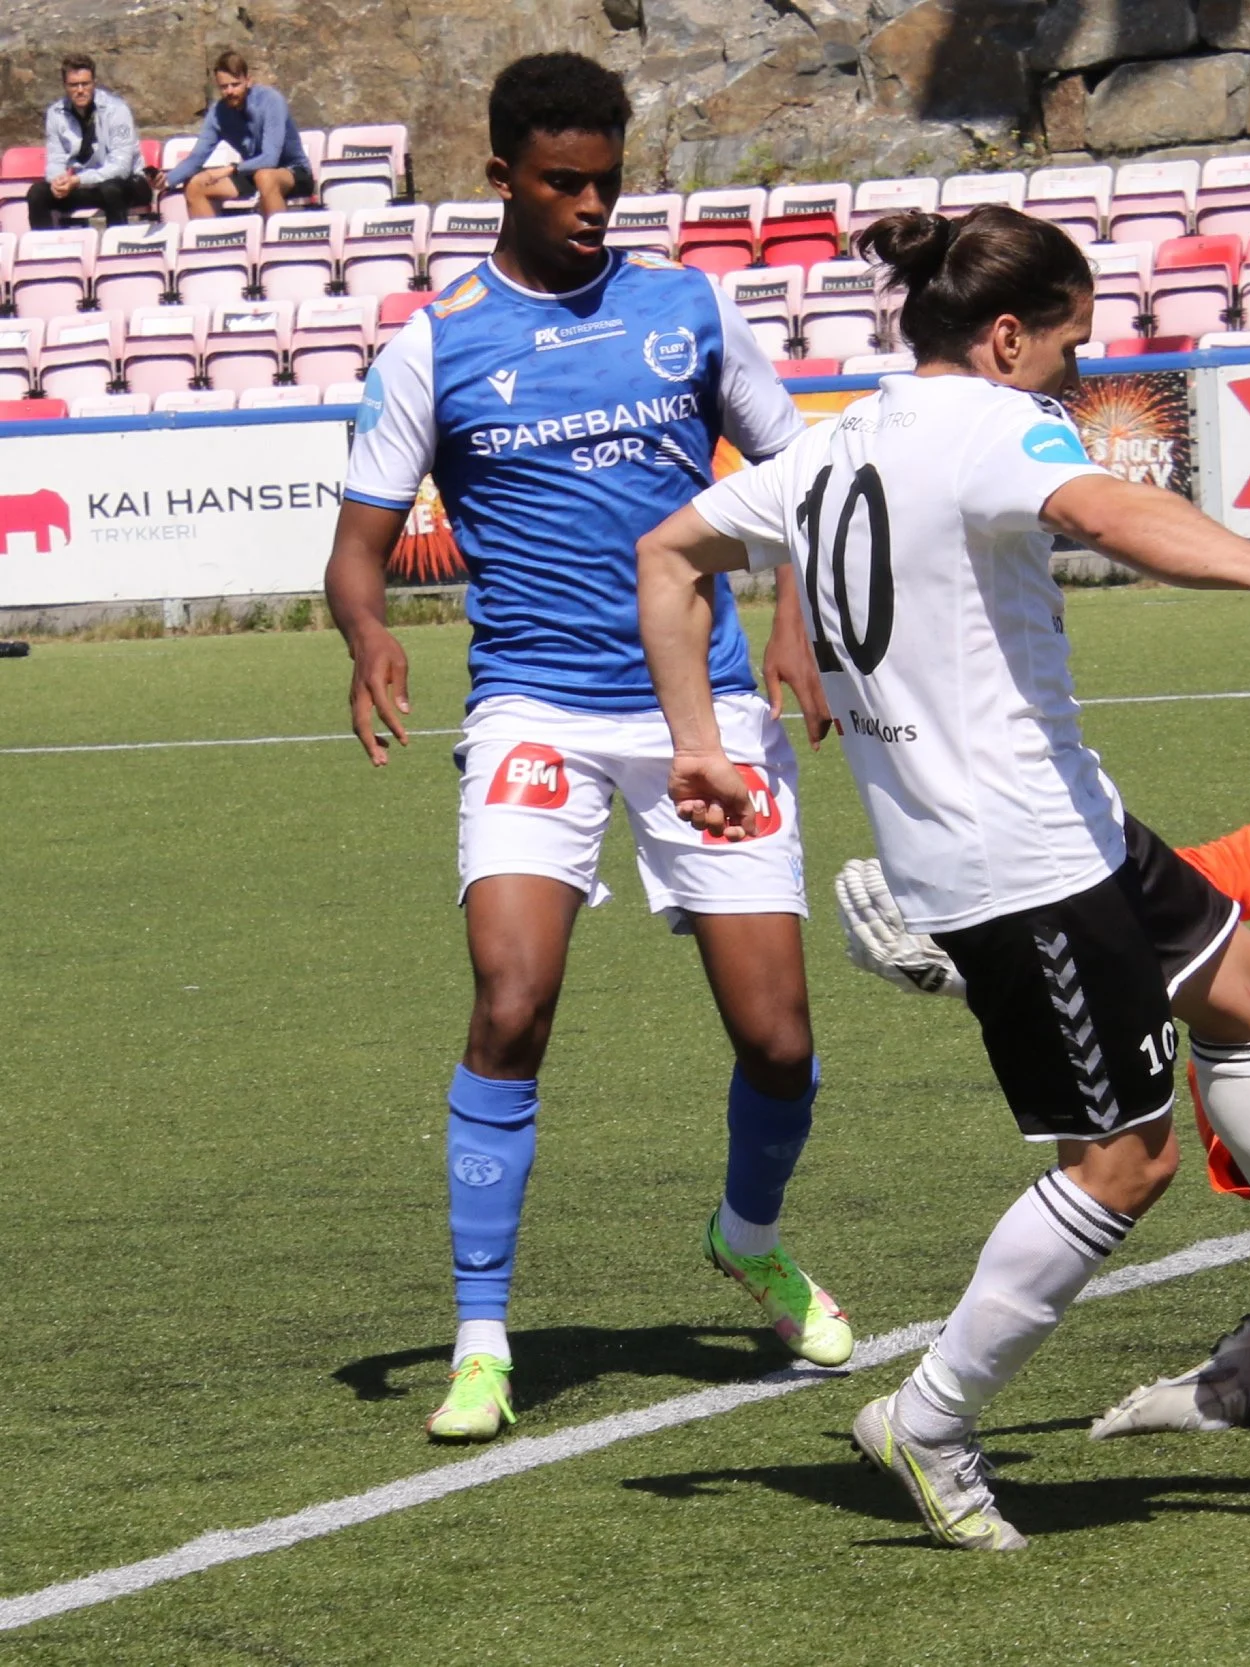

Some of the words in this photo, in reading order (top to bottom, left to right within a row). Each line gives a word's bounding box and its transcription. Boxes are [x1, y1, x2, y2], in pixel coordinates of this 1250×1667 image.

[701, 210, 749, 220] DIAMANT
[785, 204, 834, 215] DIAMANT
[449, 221, 498, 231] DIAMANT
[618, 216, 665, 226] DIAMANT
[281, 230, 328, 242] DIAMANT
[366, 224, 412, 236] DIAMANT
[198, 236, 246, 249] DIAMANT
[824, 280, 874, 291] DIAMANT
[738, 286, 787, 299] DIAMANT
[571, 437, 646, 472] SØR
[1115, 439, 1175, 462] ROCK
[88, 491, 150, 519] KAI
[167, 481, 342, 515] HANSEN
[91, 524, 198, 543] TRYKKERI
[797, 463, 895, 676] 10
[507, 757, 558, 792] BM
[1139, 1020, 1175, 1077] 10
